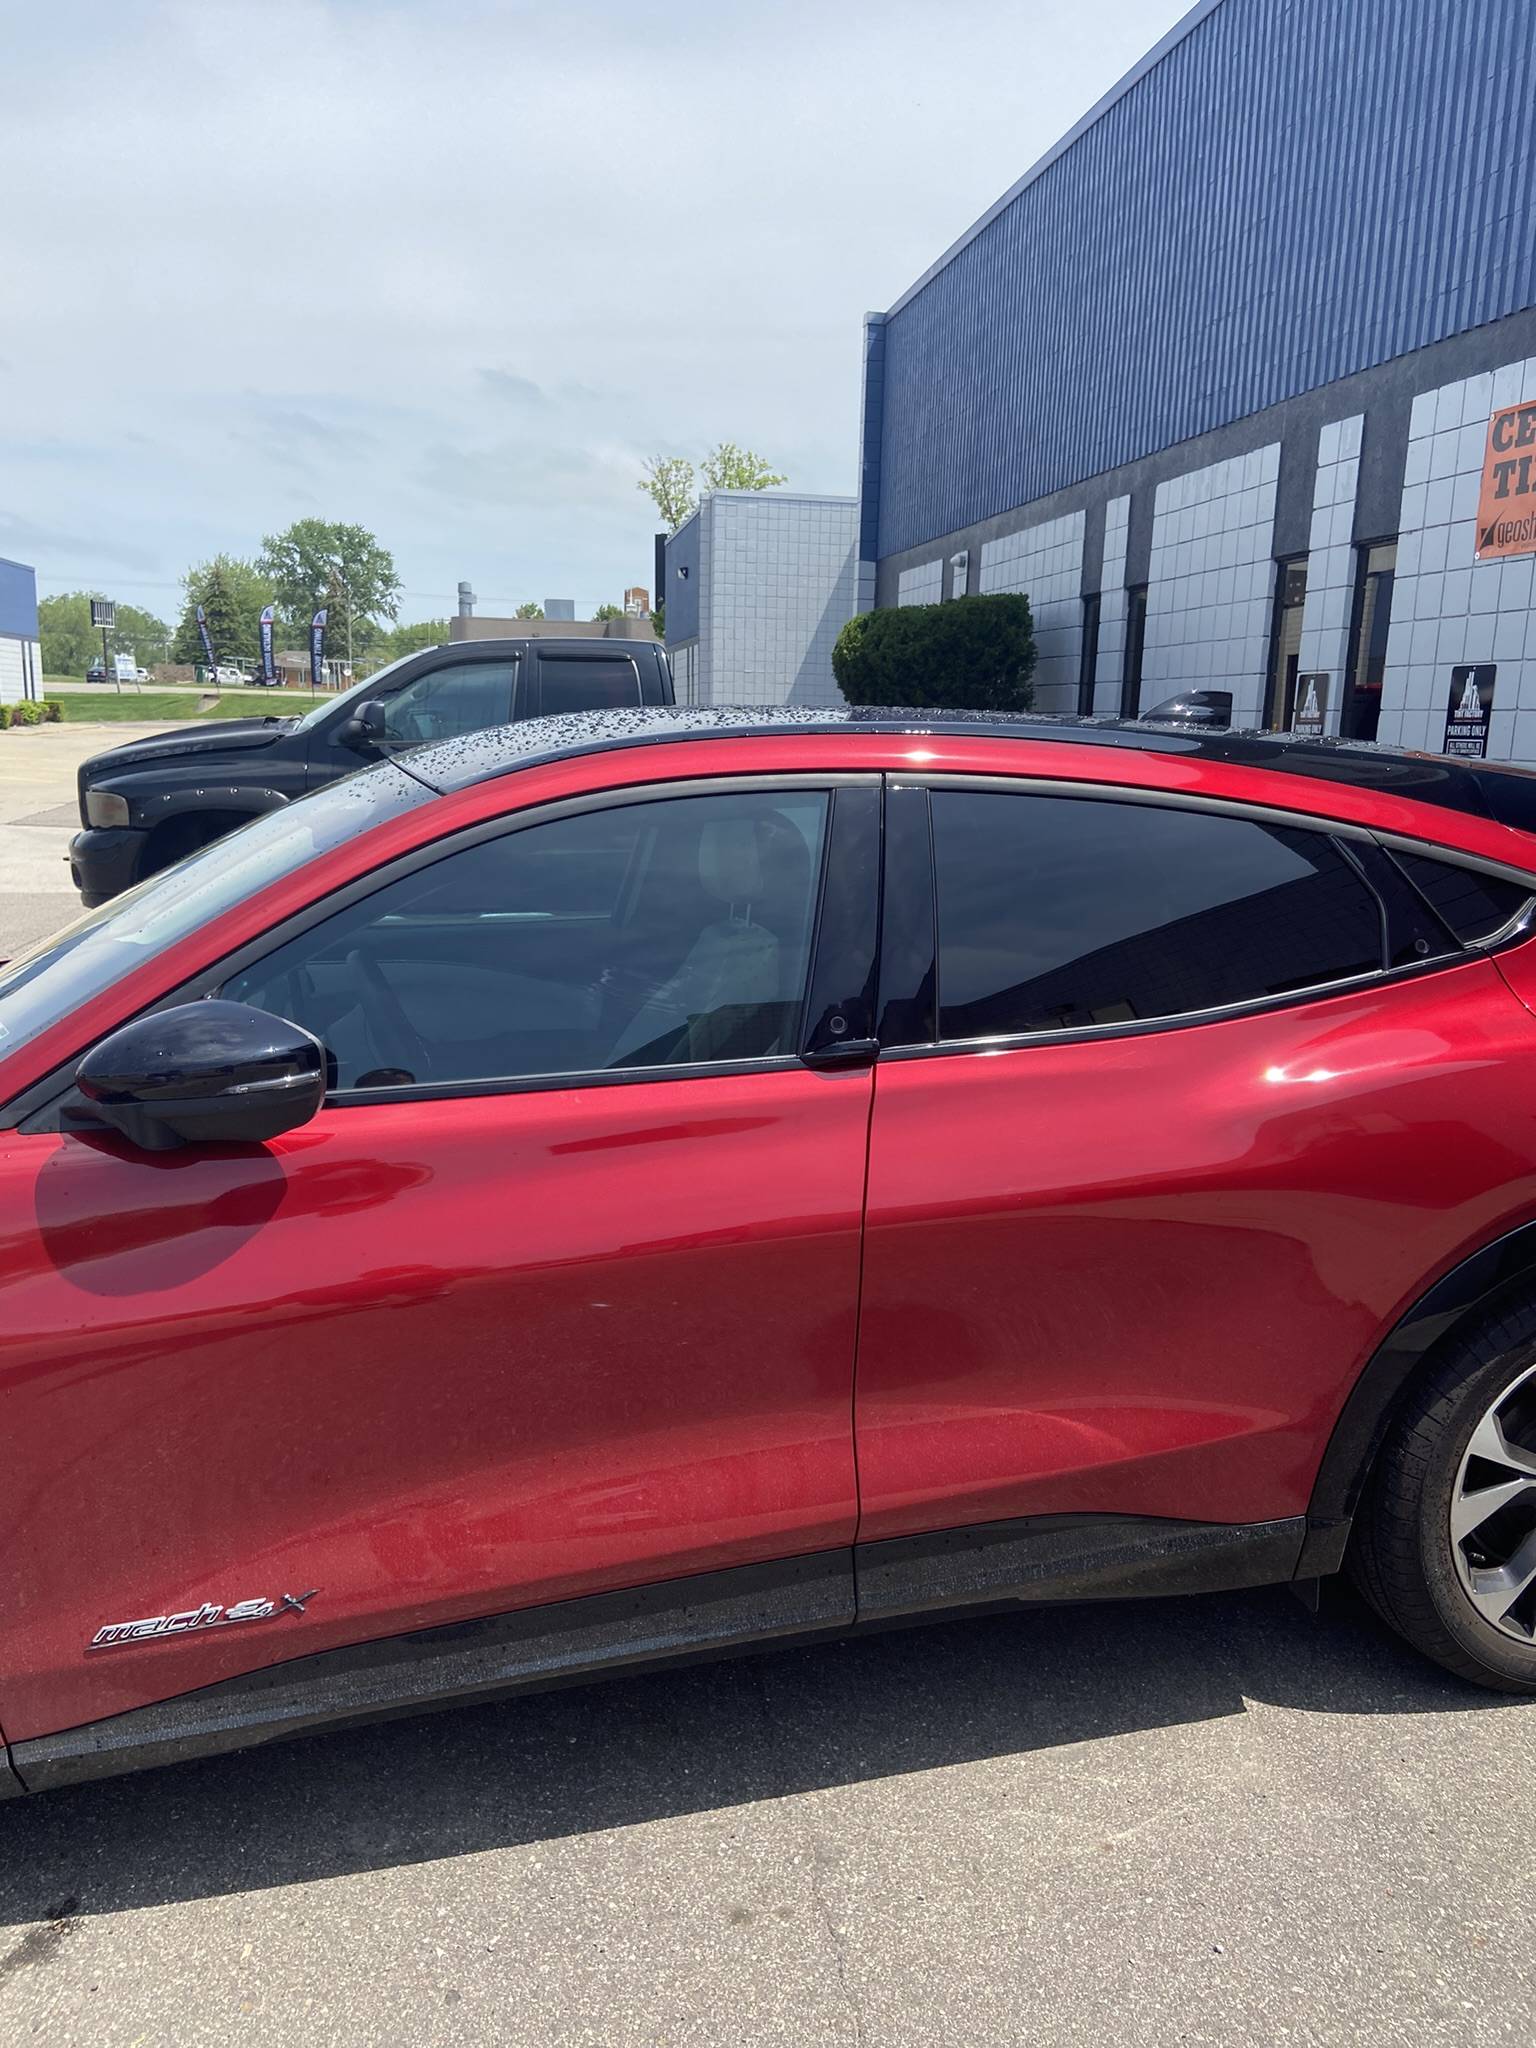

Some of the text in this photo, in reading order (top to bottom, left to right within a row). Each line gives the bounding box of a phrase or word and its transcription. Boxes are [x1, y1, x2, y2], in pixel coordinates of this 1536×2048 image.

[1493, 455, 1536, 500] TI
[313, 628, 323, 655] TINTING
[1447, 725, 1487, 736] PARKING ONLY
